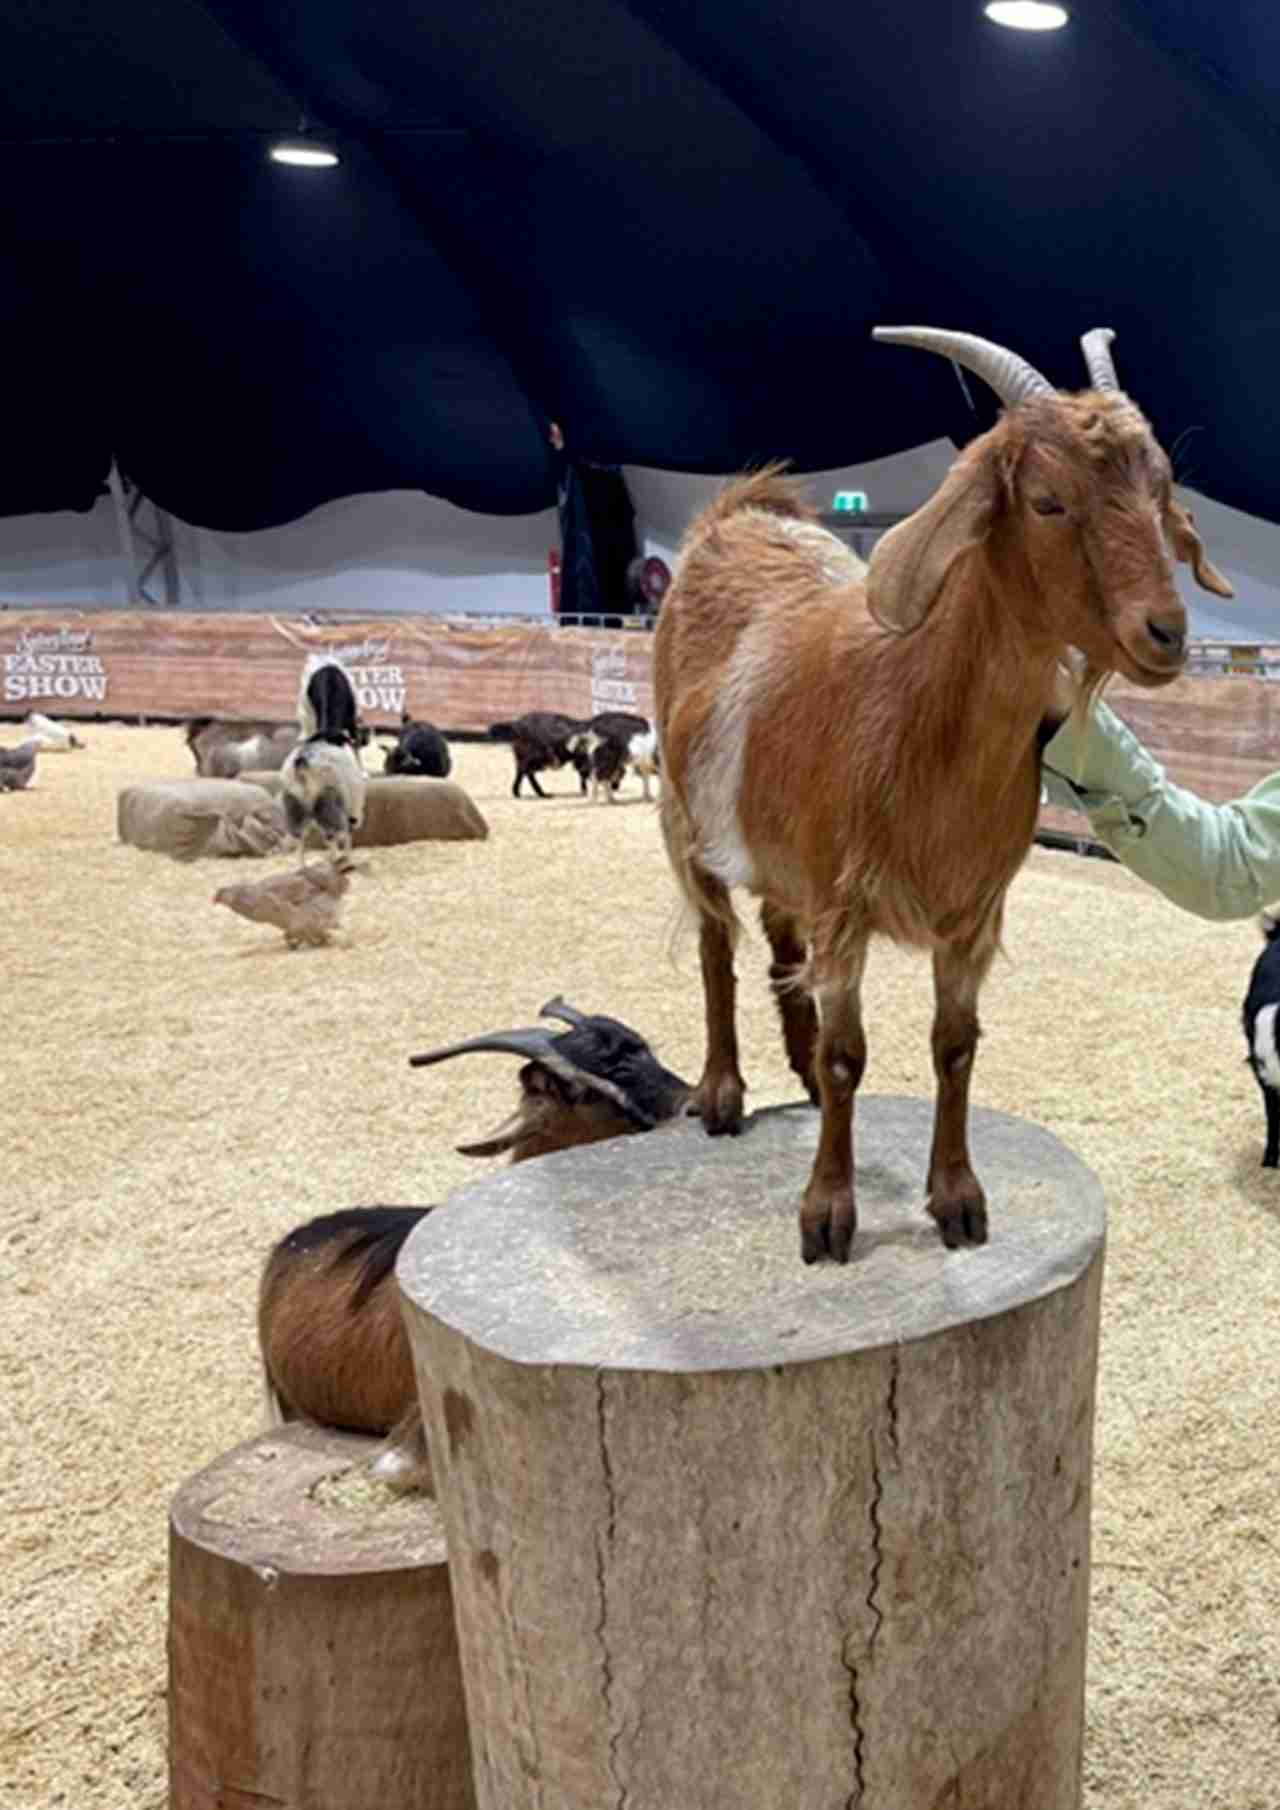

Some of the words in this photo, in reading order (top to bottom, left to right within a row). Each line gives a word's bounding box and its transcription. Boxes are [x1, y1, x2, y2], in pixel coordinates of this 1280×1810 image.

[4, 654, 104, 673] EASTER
[353, 665, 404, 685] TER
[4, 674, 108, 701] SHOW
[357, 686, 406, 713] OW
